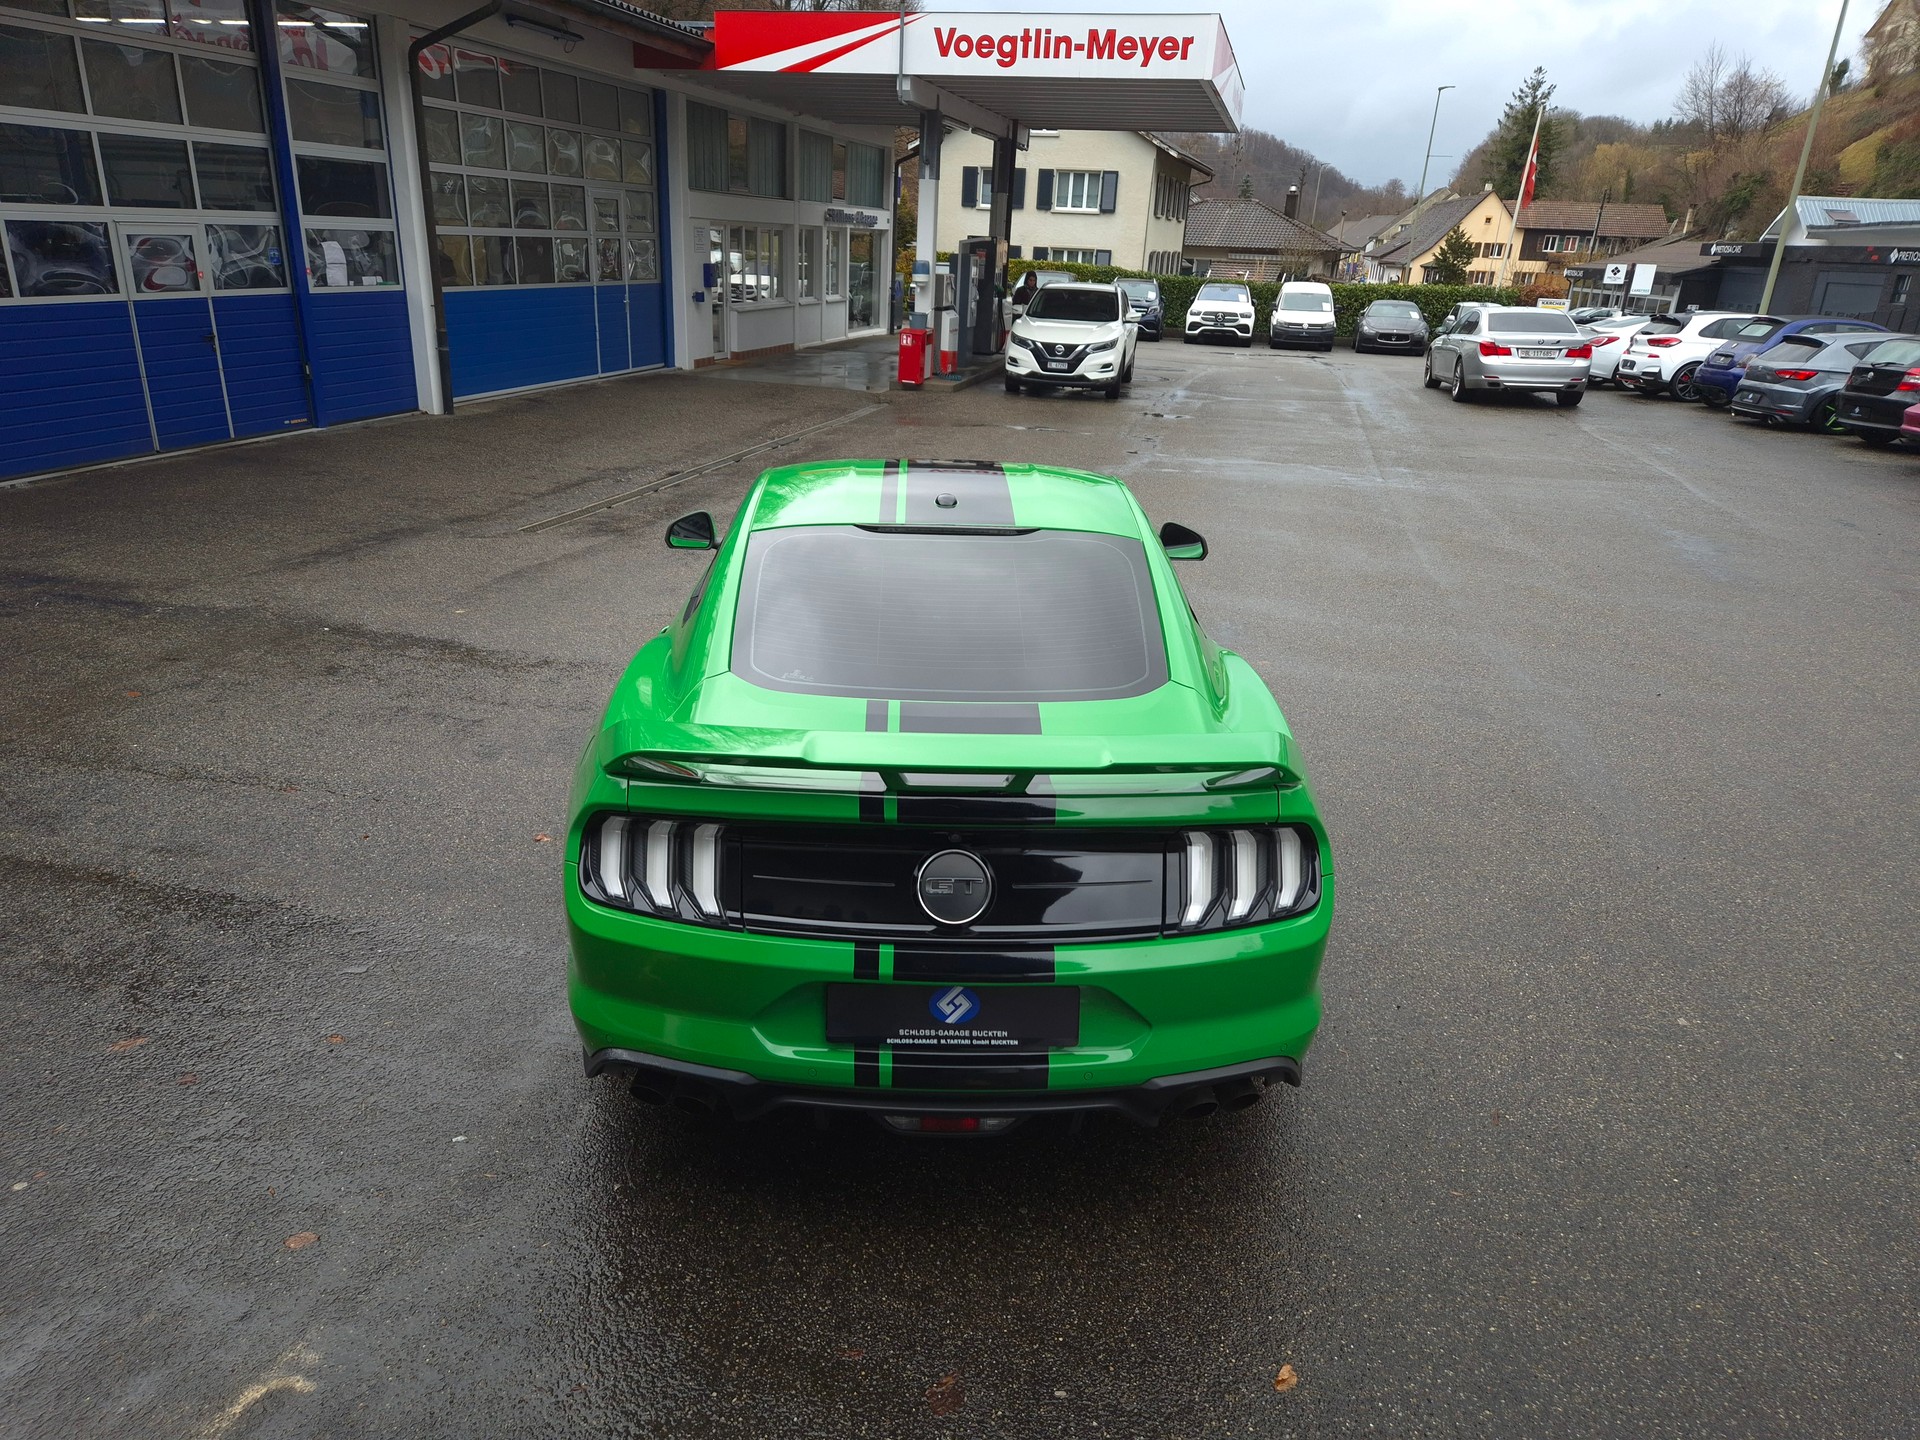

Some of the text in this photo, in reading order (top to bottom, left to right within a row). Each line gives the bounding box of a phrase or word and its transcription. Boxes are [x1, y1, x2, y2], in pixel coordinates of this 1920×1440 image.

[933, 27, 1194, 68] Voegtlin-Meyer
[925, 877, 983, 894] GT
[899, 1029, 970, 1037] SCHLOSS-GARAGE
